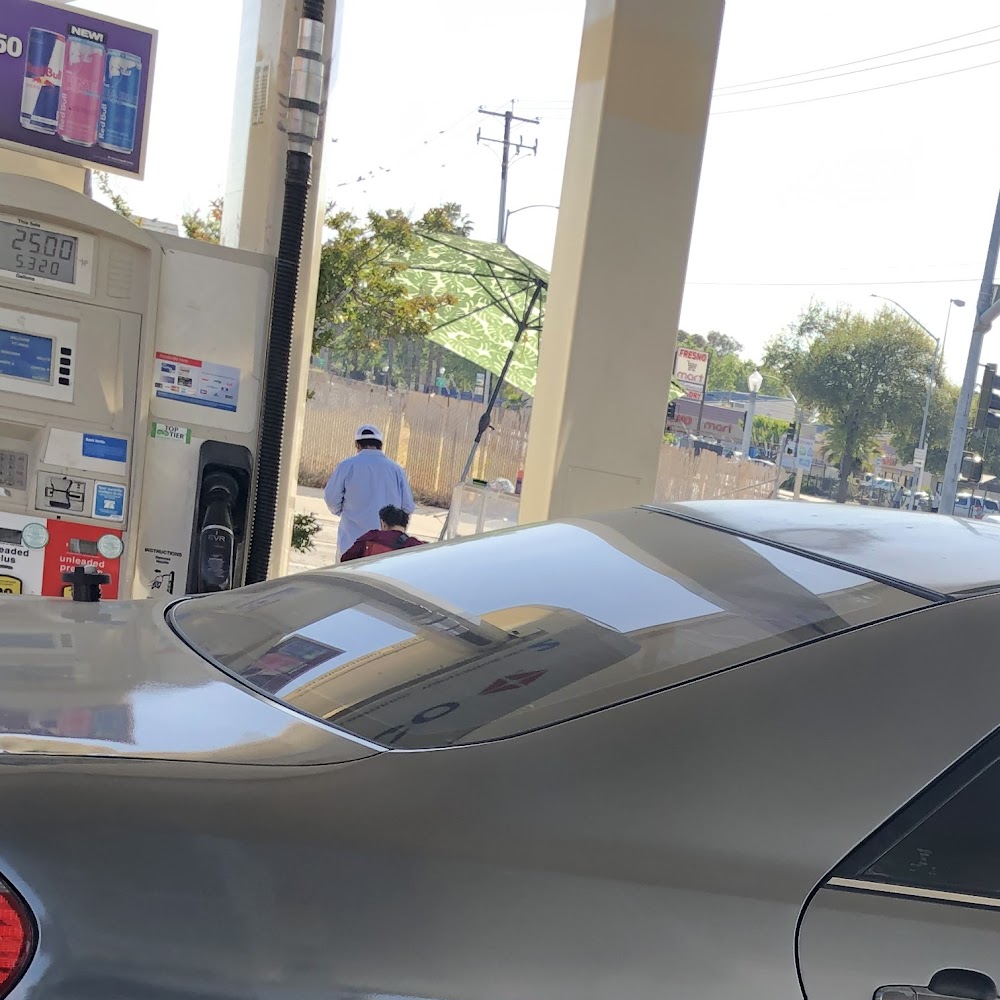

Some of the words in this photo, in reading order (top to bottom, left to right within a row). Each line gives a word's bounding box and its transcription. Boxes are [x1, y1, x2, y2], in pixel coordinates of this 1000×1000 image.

[678, 349, 708, 363] FRESNO
[676, 371, 704, 383] mart
[164, 423, 179, 432] TOP
[703, 420, 734, 434] mart
[168, 431, 185, 440] TIER
[207, 534, 226, 542] EVR
[59, 555, 105, 569] unleaded
